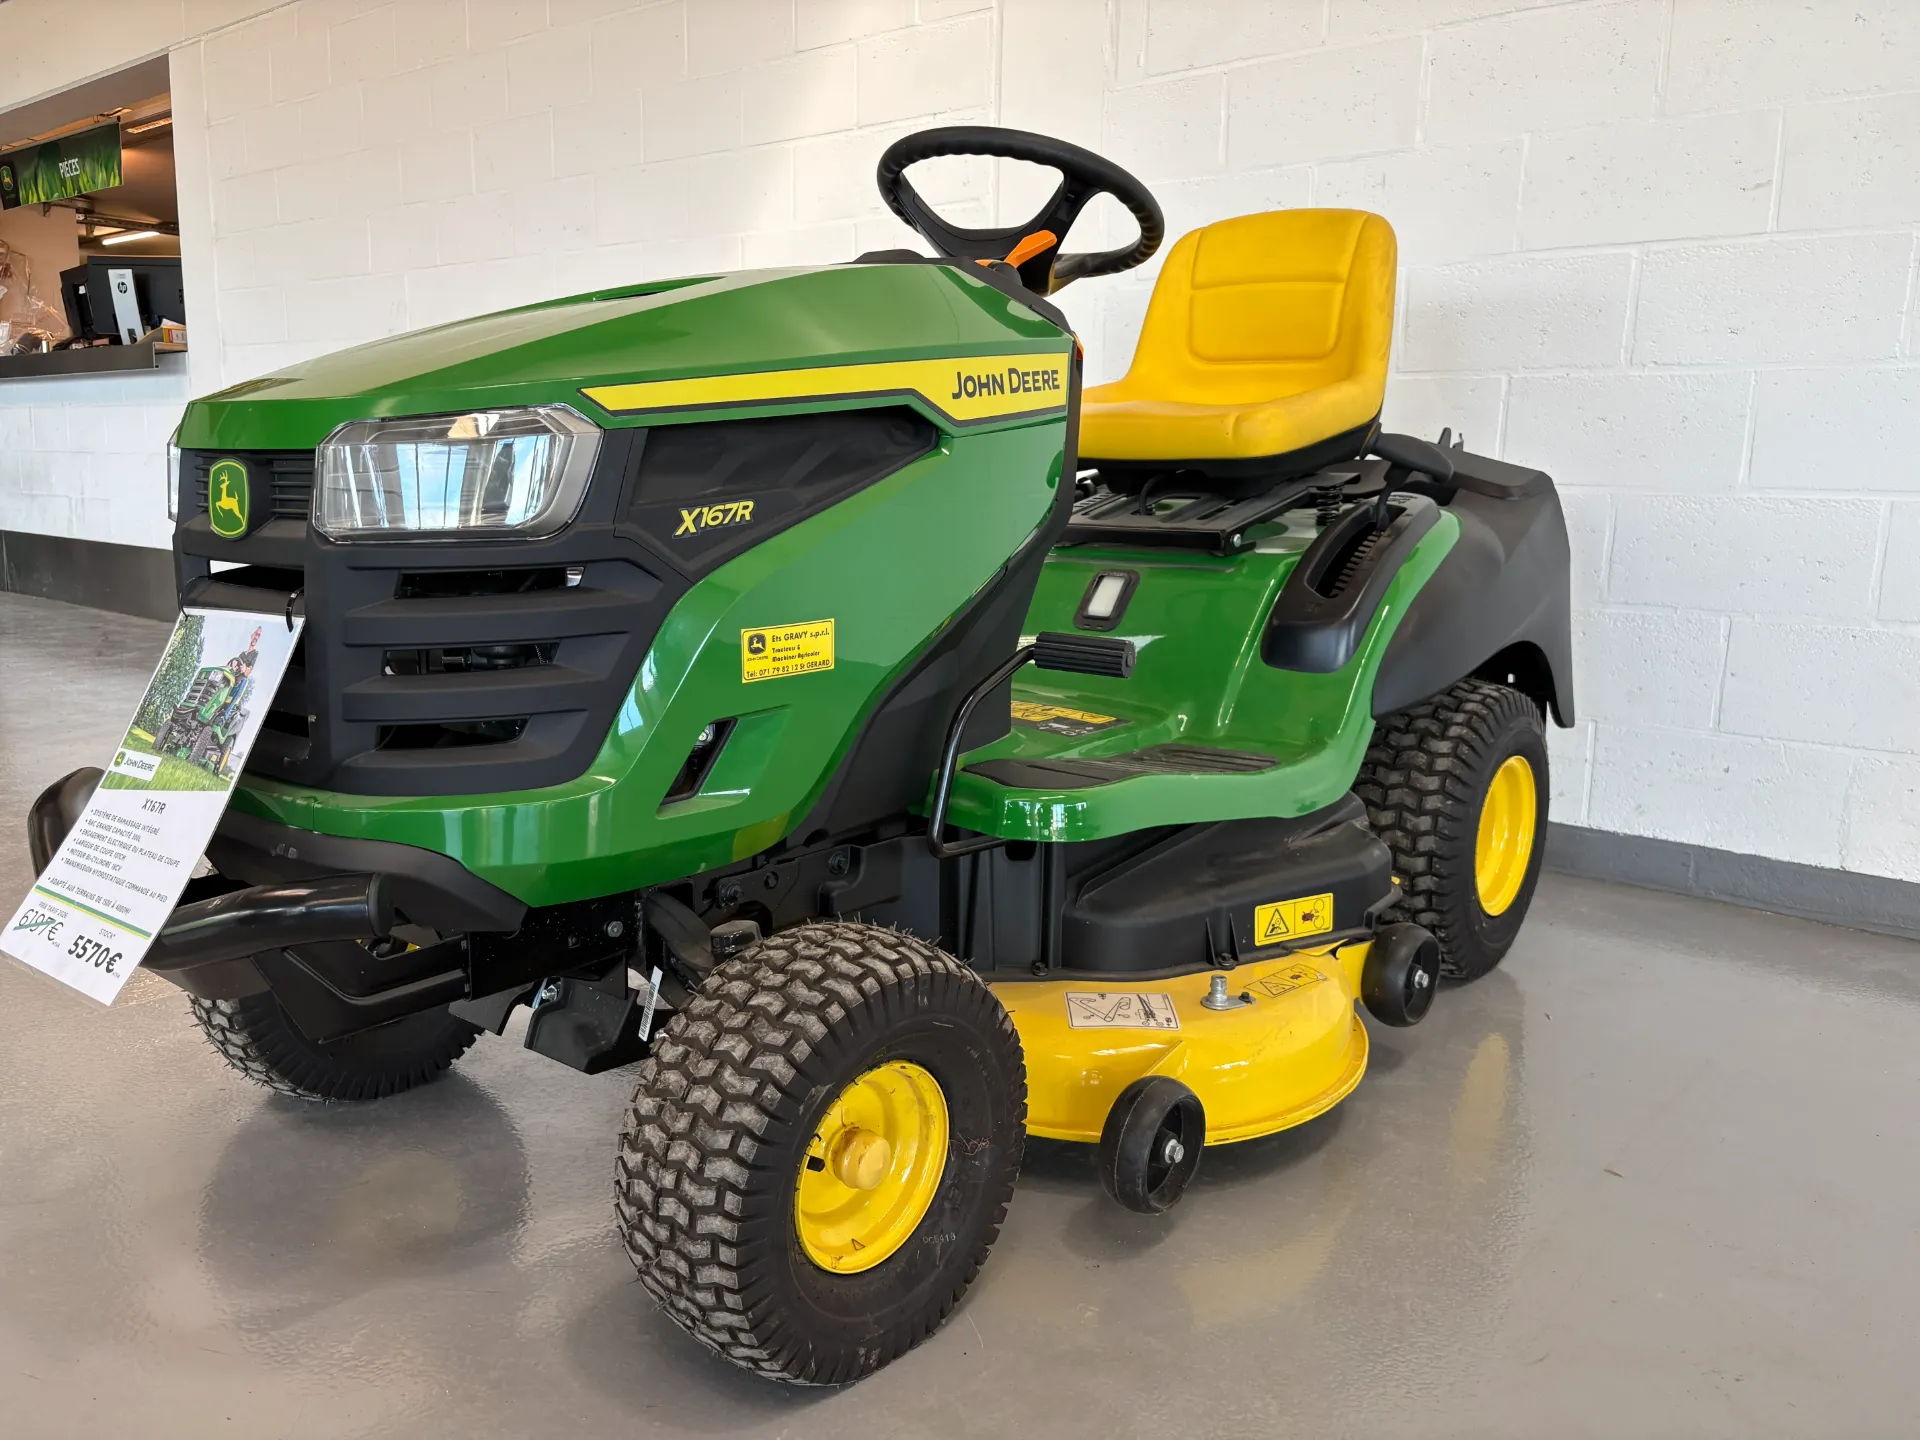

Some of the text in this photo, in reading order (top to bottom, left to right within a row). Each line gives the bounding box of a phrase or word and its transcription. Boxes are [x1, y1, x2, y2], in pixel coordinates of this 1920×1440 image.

[59, 157, 80, 178] PIÈCES
[675, 500, 754, 536] X167R
[772, 635, 782, 643] Ets
[784, 631, 808, 641] GRAVY
[142, 798, 166, 815] X167R
[67, 934, 123, 974] 5570€
